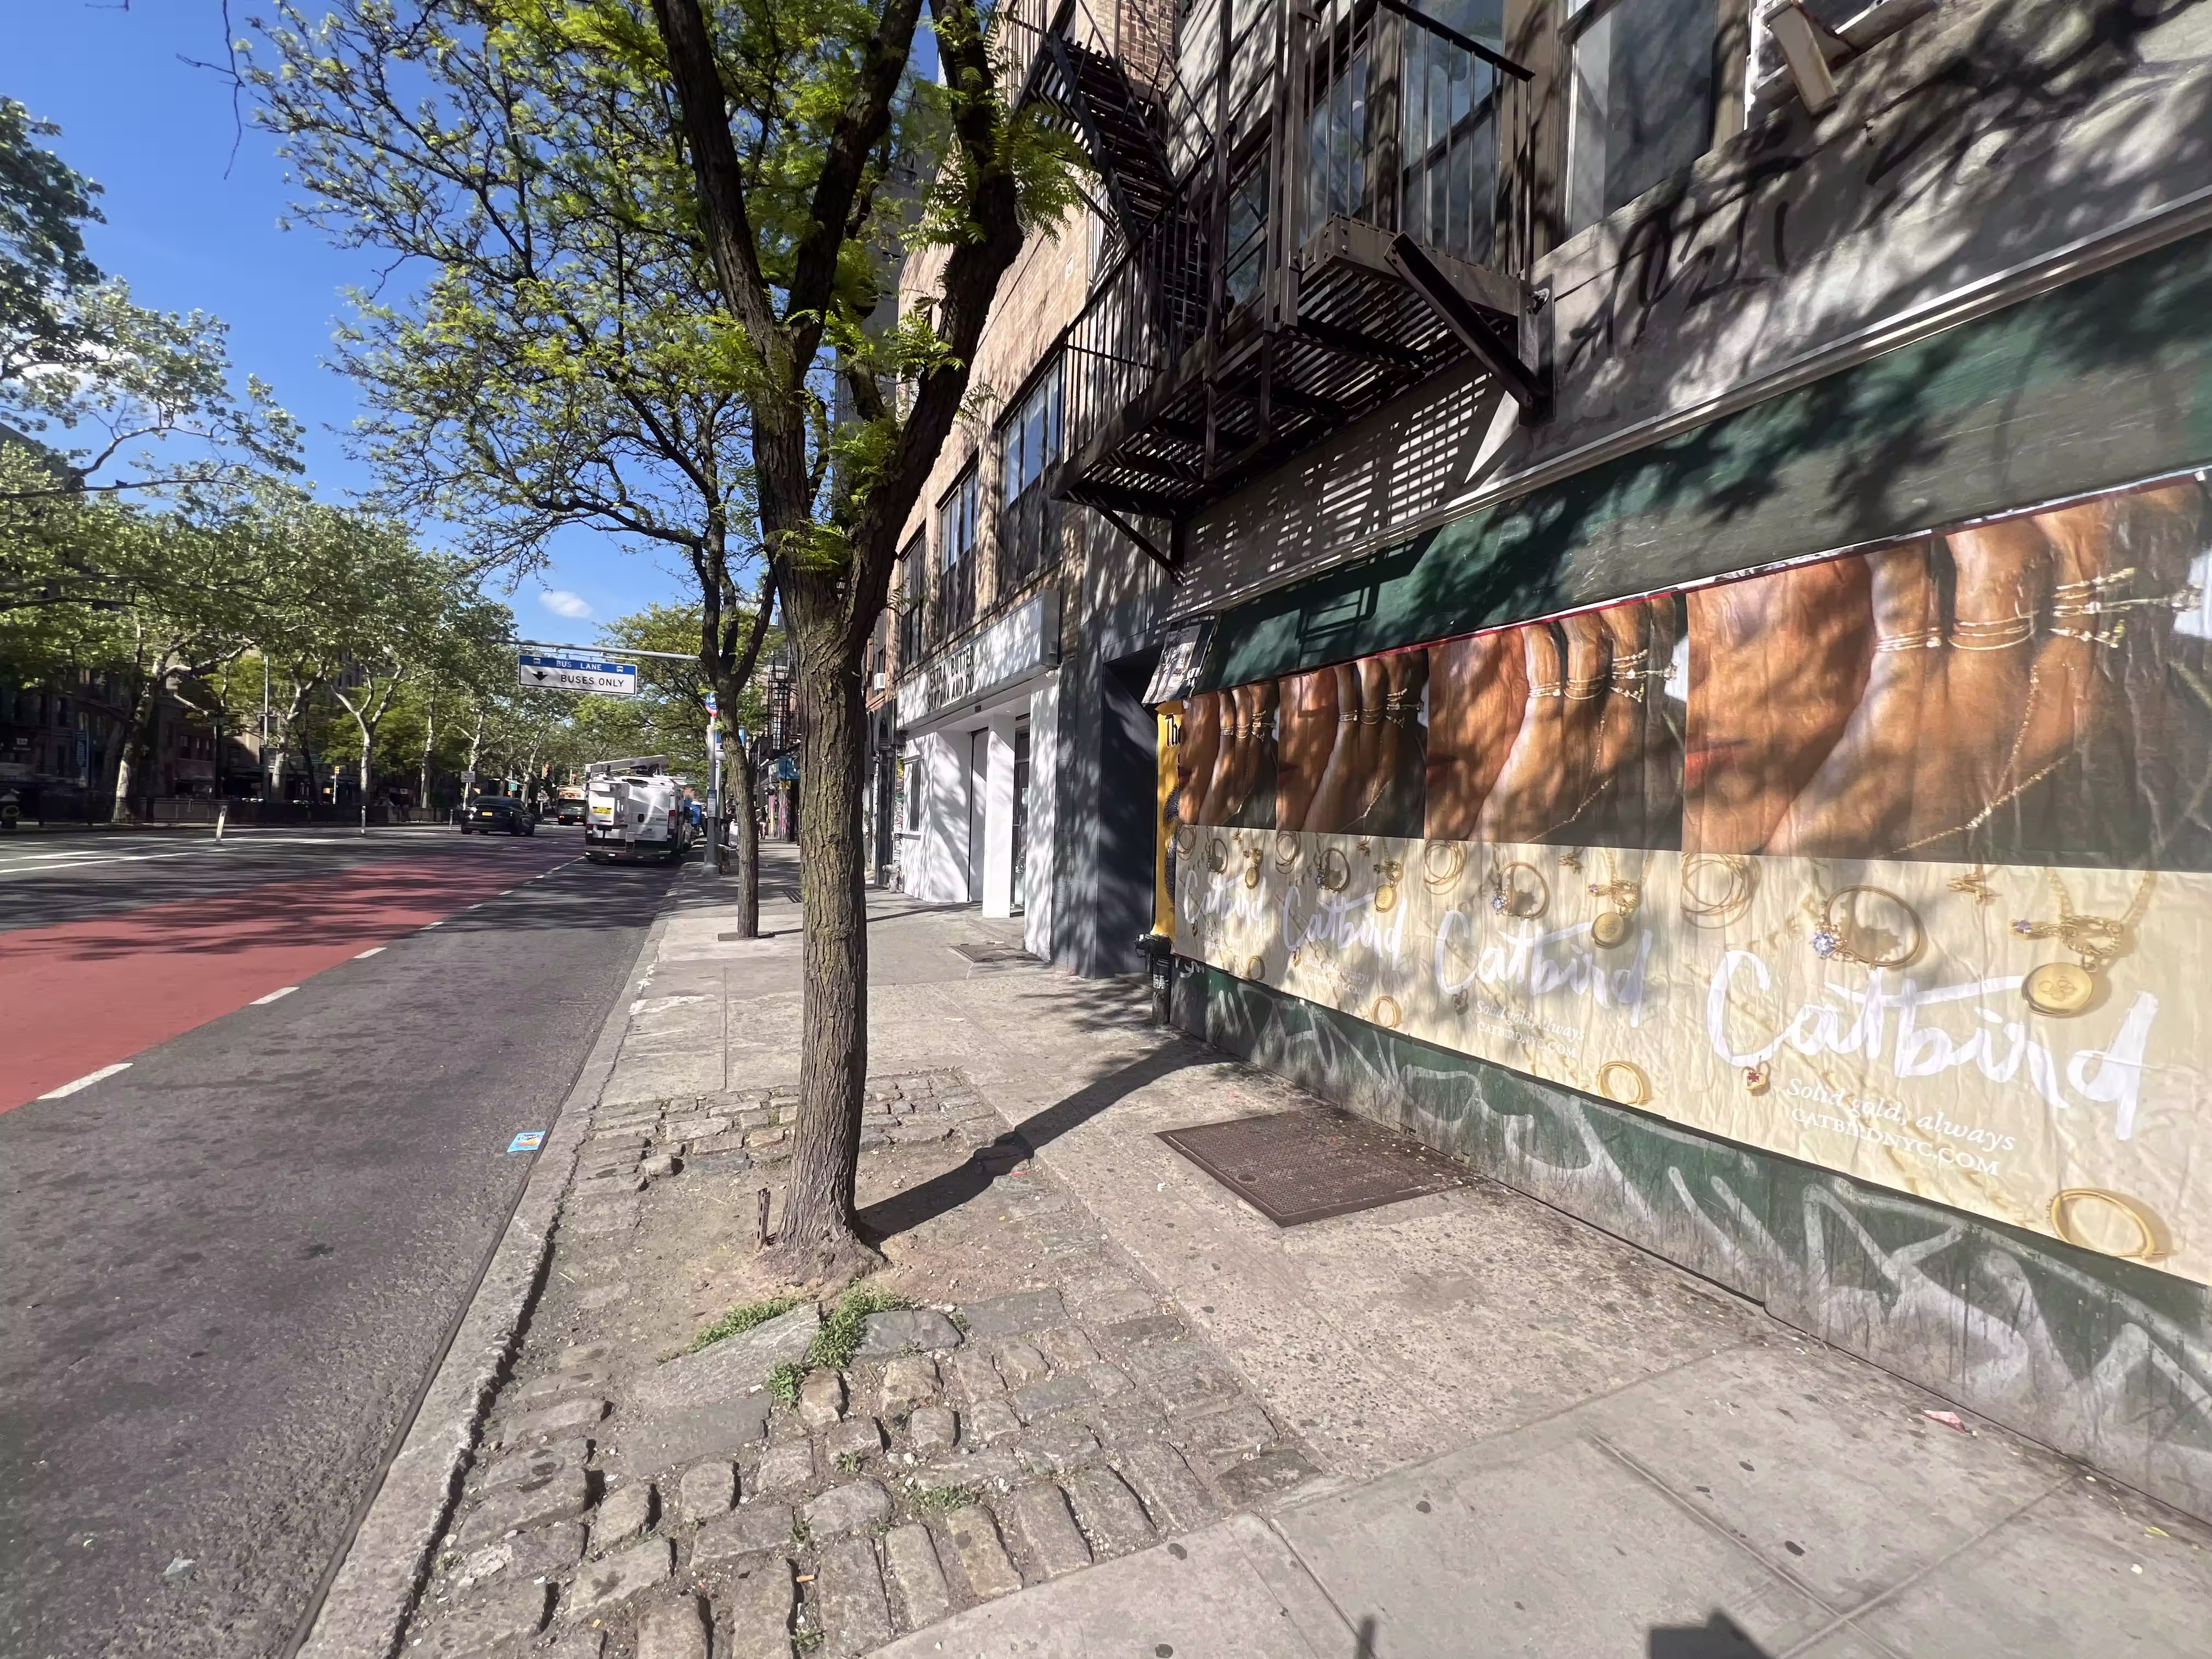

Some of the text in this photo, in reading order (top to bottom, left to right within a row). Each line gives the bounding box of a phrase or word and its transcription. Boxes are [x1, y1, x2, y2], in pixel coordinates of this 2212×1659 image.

[561, 674, 624, 687] BUSES ONLY
[930, 645, 974, 689] EXTRA BUTTER
[952, 676, 963, 699] AND
[965, 670, 974, 693] CO
[1183, 870, 1267, 936] Catbird
[1283, 885, 1407, 971] Catbird
[1435, 910, 1653, 1028] Catbird
[1475, 1000, 1584, 1042] Solid gold, always
[1477, 1022, 1576, 1058] CATBIRDNYC.COM
[1707, 950, 2159, 1141] Catbird
[1787, 1078, 2017, 1152] Solid gold, always
[1791, 1108, 2000, 1175] CATBIRDNYC.COM
